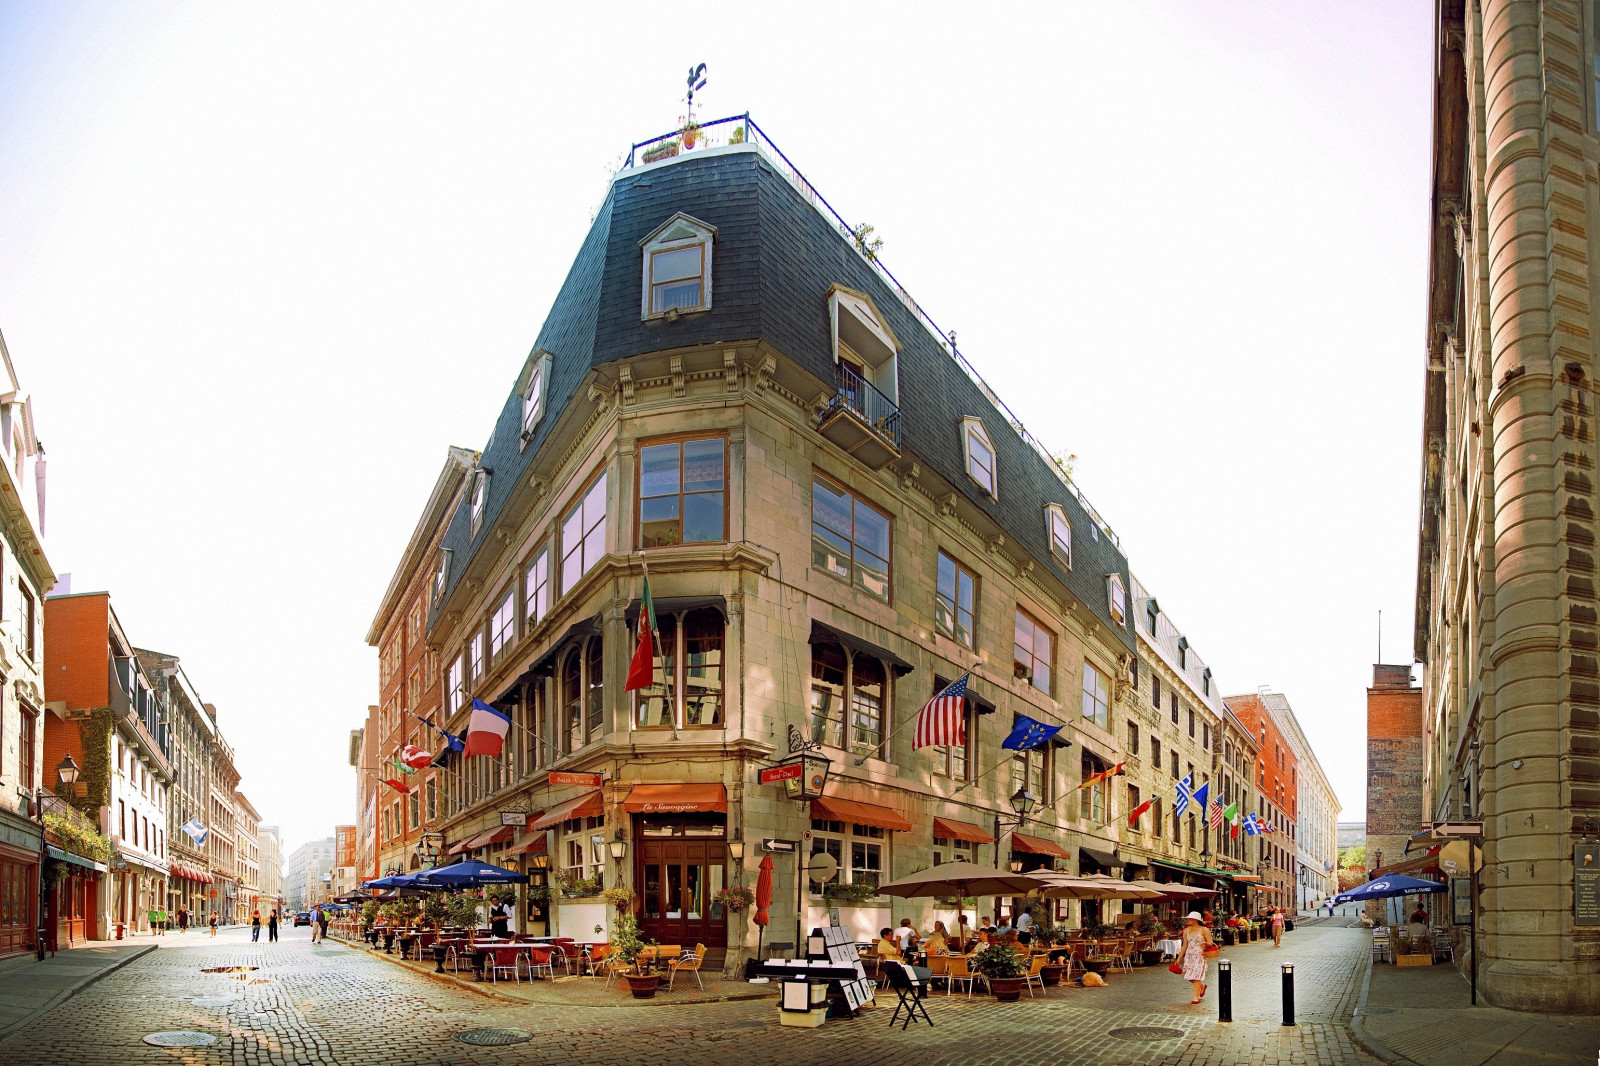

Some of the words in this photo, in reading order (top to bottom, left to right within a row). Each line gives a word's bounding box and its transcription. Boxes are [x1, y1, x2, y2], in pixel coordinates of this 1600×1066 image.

[769, 770, 794, 780] Saint-Paul
[556, 776, 594, 785] Saint-Vincent
[642, 803, 653, 811] La
[655, 802, 698, 811] Sauvagine
